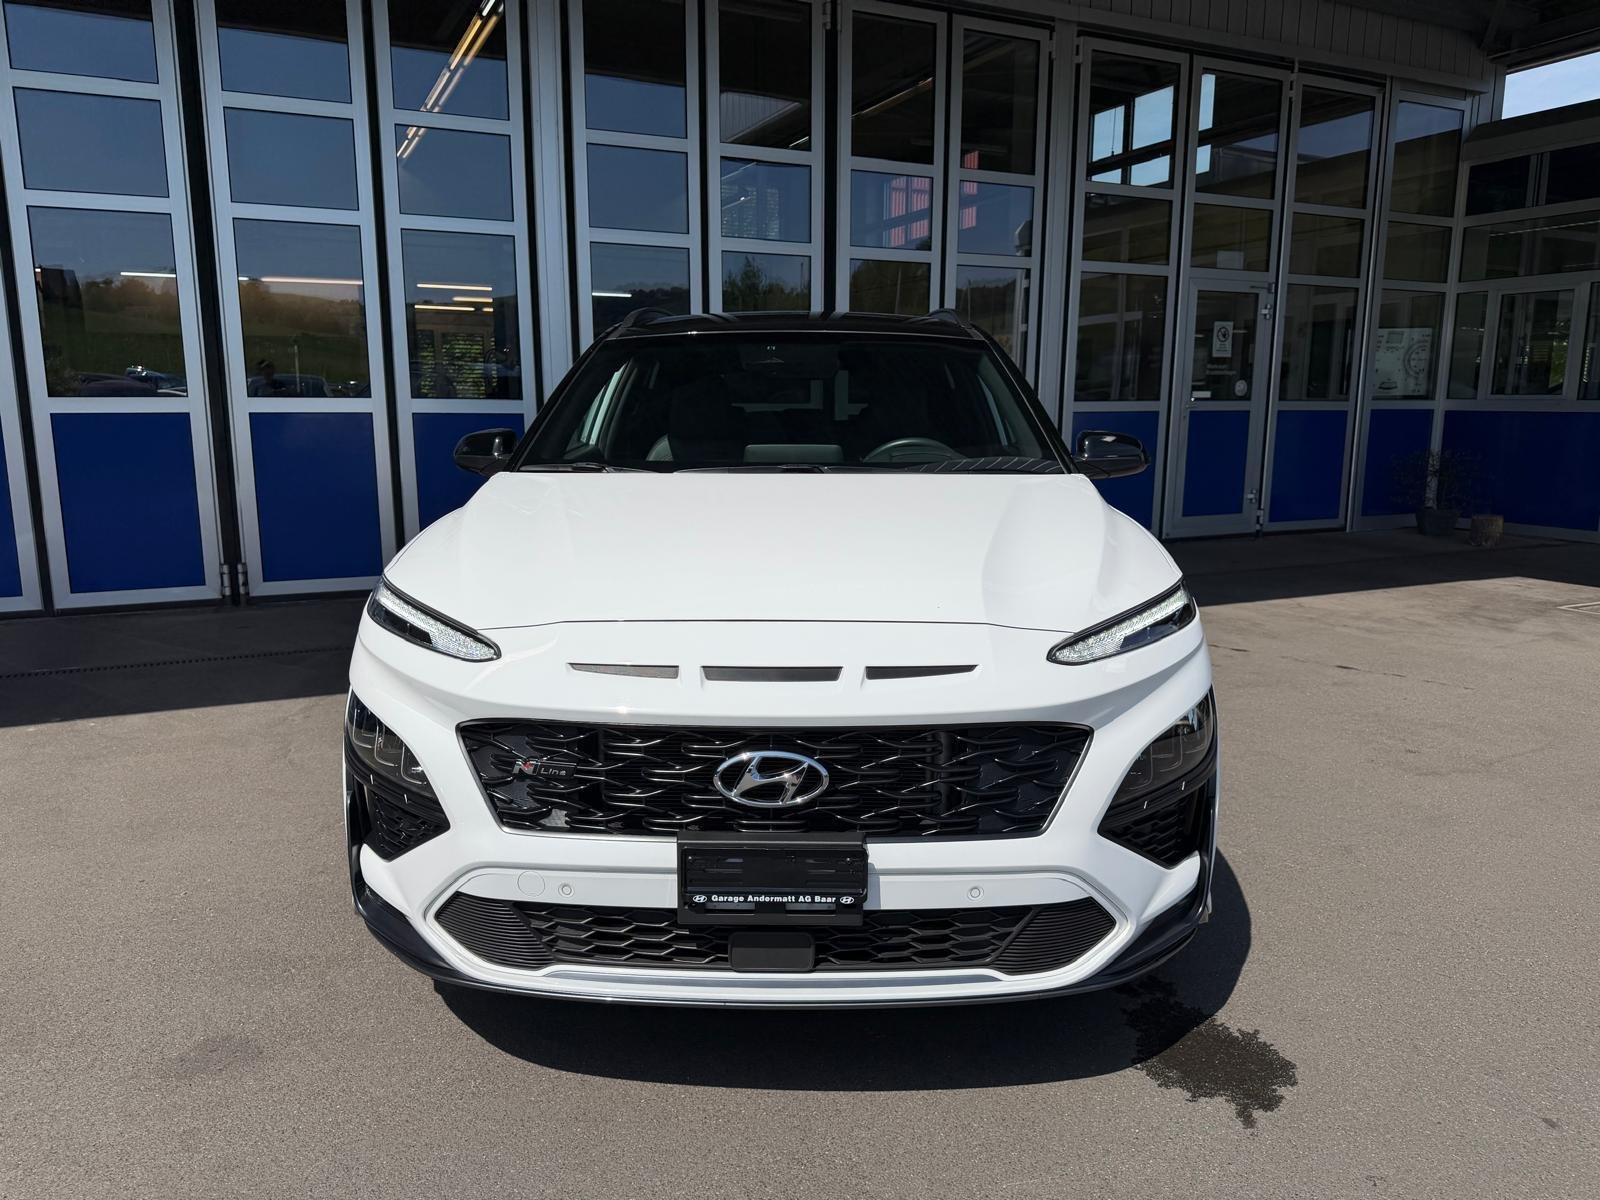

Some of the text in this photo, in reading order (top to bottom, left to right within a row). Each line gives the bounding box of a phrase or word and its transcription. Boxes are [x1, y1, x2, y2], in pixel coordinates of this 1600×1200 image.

[540, 767, 567, 776] Line
[711, 894, 837, 904] Garage Andermatt AG Baar
